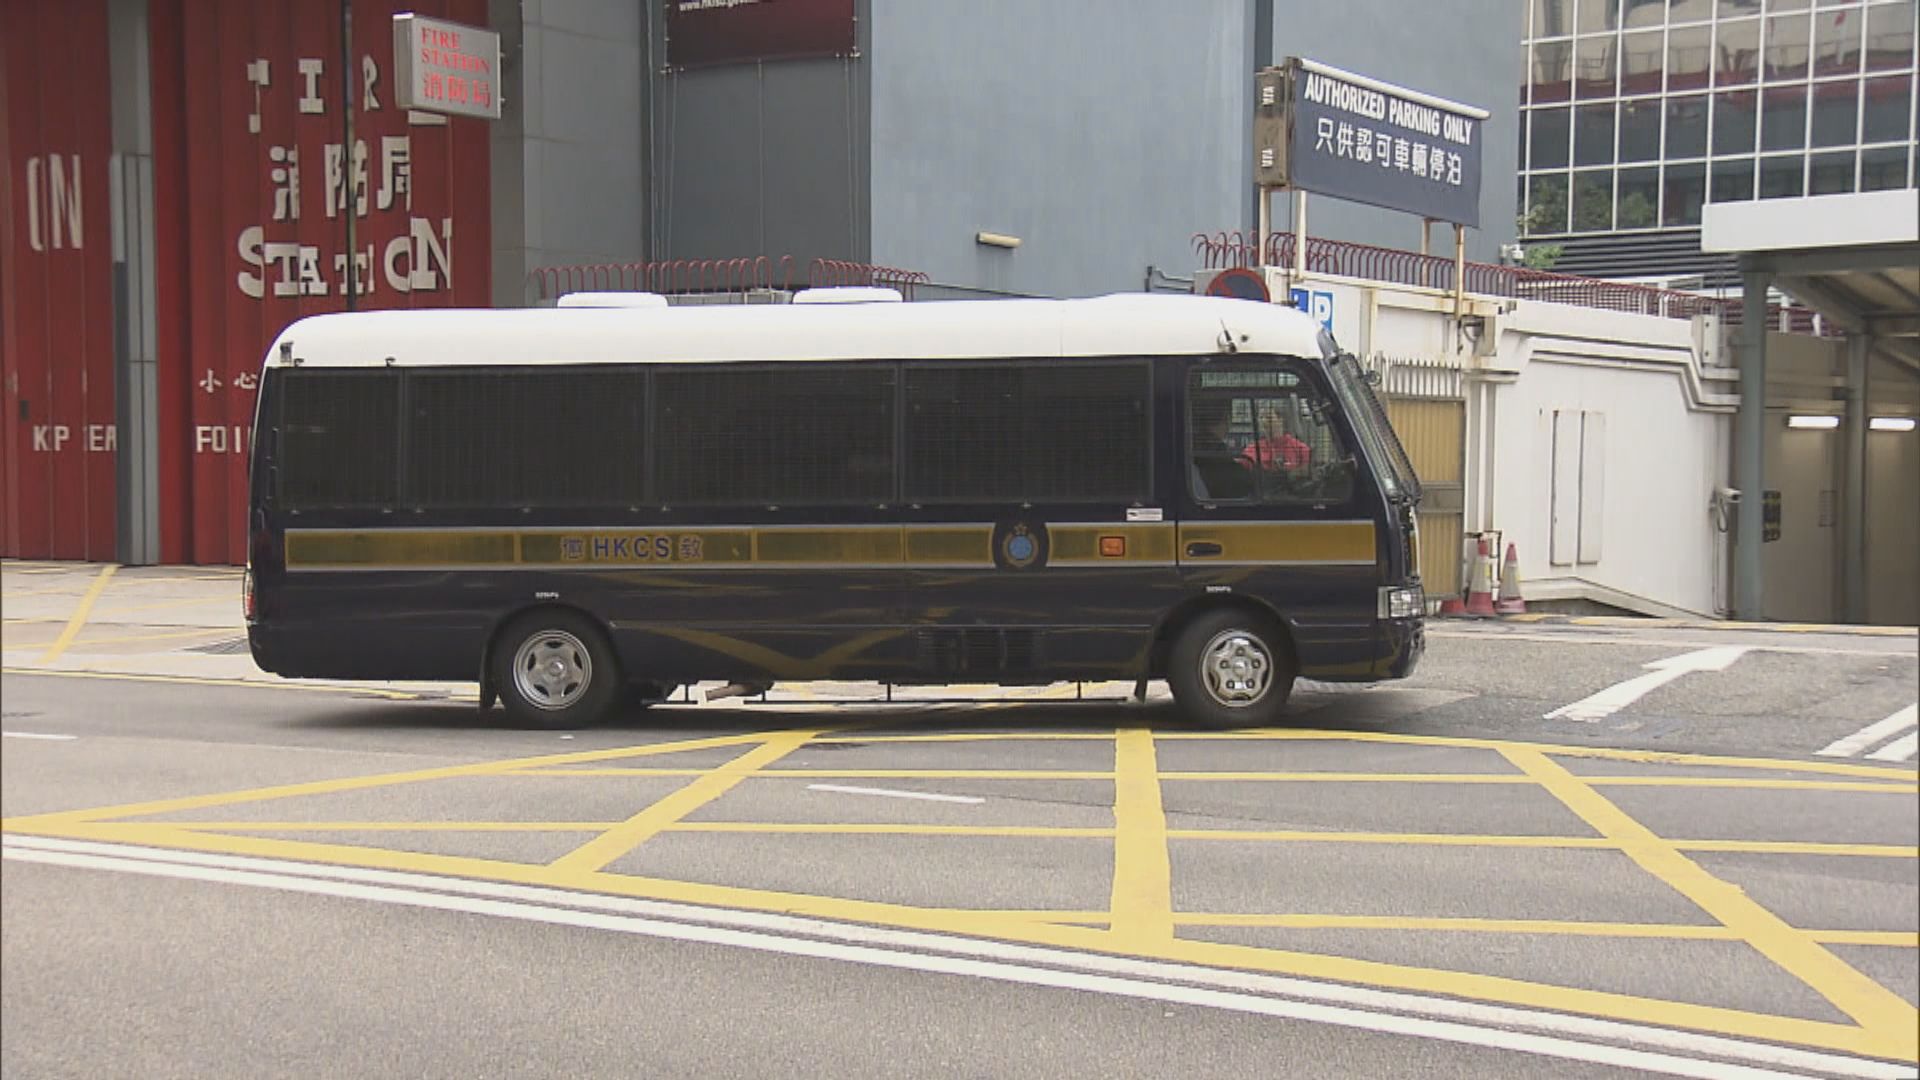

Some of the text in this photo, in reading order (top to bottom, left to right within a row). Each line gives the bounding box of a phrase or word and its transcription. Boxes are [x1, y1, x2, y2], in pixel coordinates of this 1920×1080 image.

[421, 26, 460, 49] FIRE
[421, 48, 491, 75] STATION
[423, 73, 491, 109] 消防局
[1304, 72, 1473, 146] AUTHORIZED PARKING ONLY
[1315, 117, 1462, 186] 只供認可車輛停泊
[594, 537, 671, 558] HKCS
